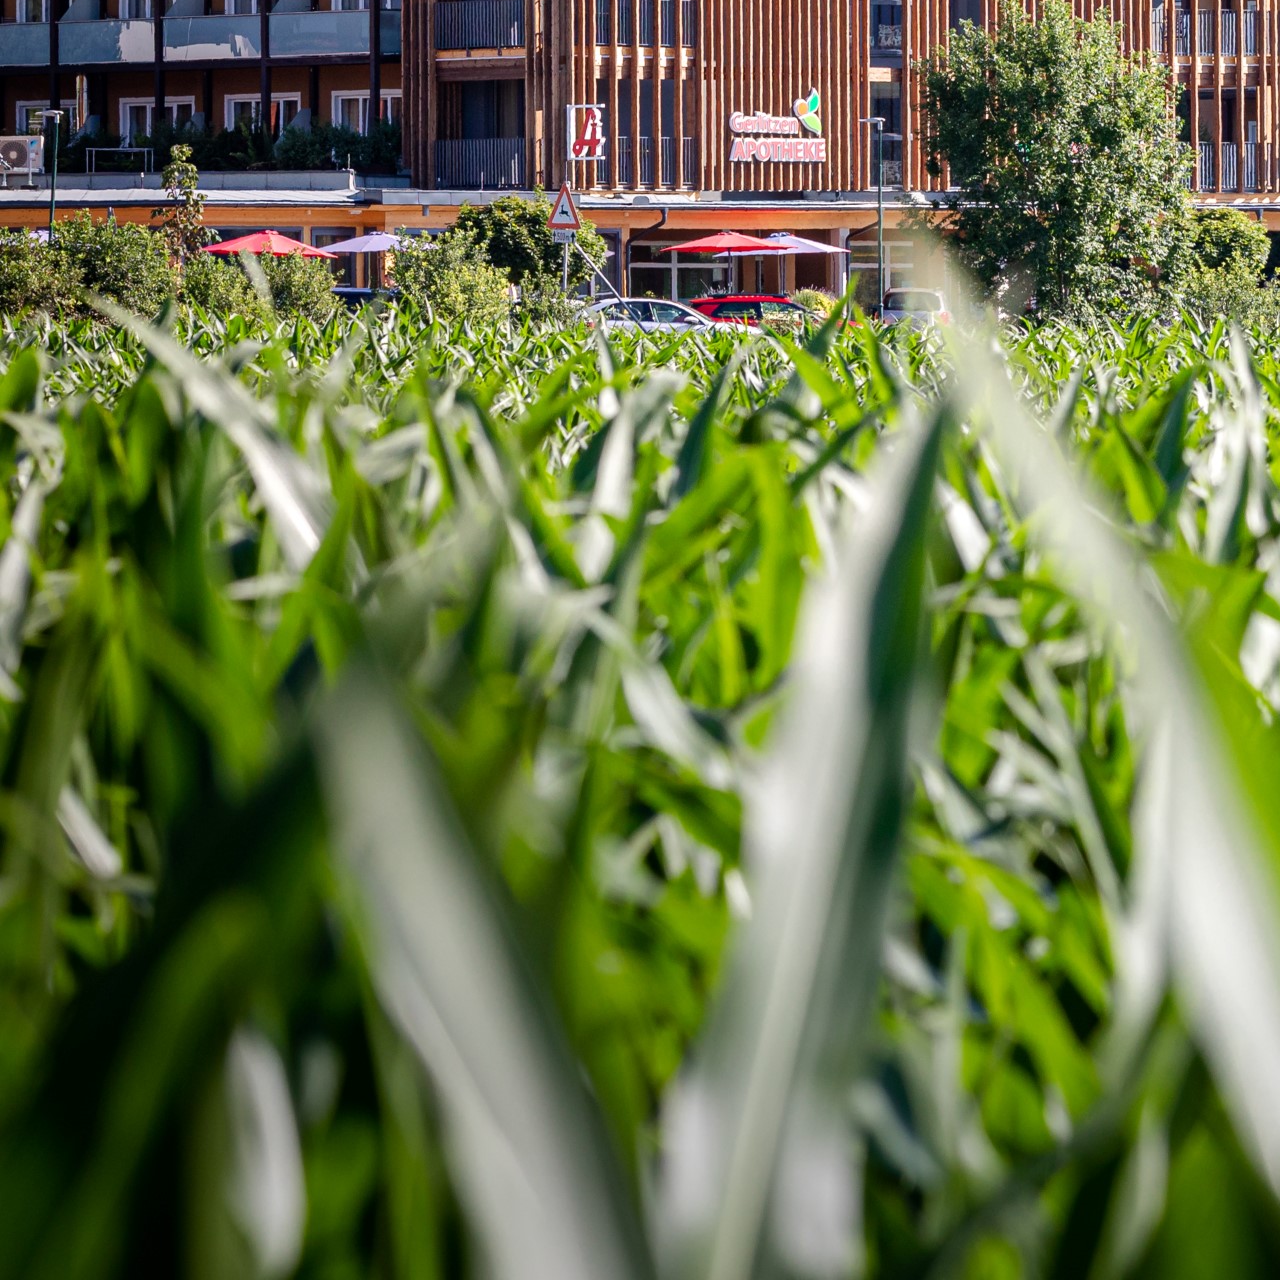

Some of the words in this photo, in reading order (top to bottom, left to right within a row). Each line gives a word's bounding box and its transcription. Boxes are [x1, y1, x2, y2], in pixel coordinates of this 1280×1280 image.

[573, 108, 602, 157] A
[731, 112, 798, 133] Gerlitzen
[731, 139, 826, 161] APOTHEKE
